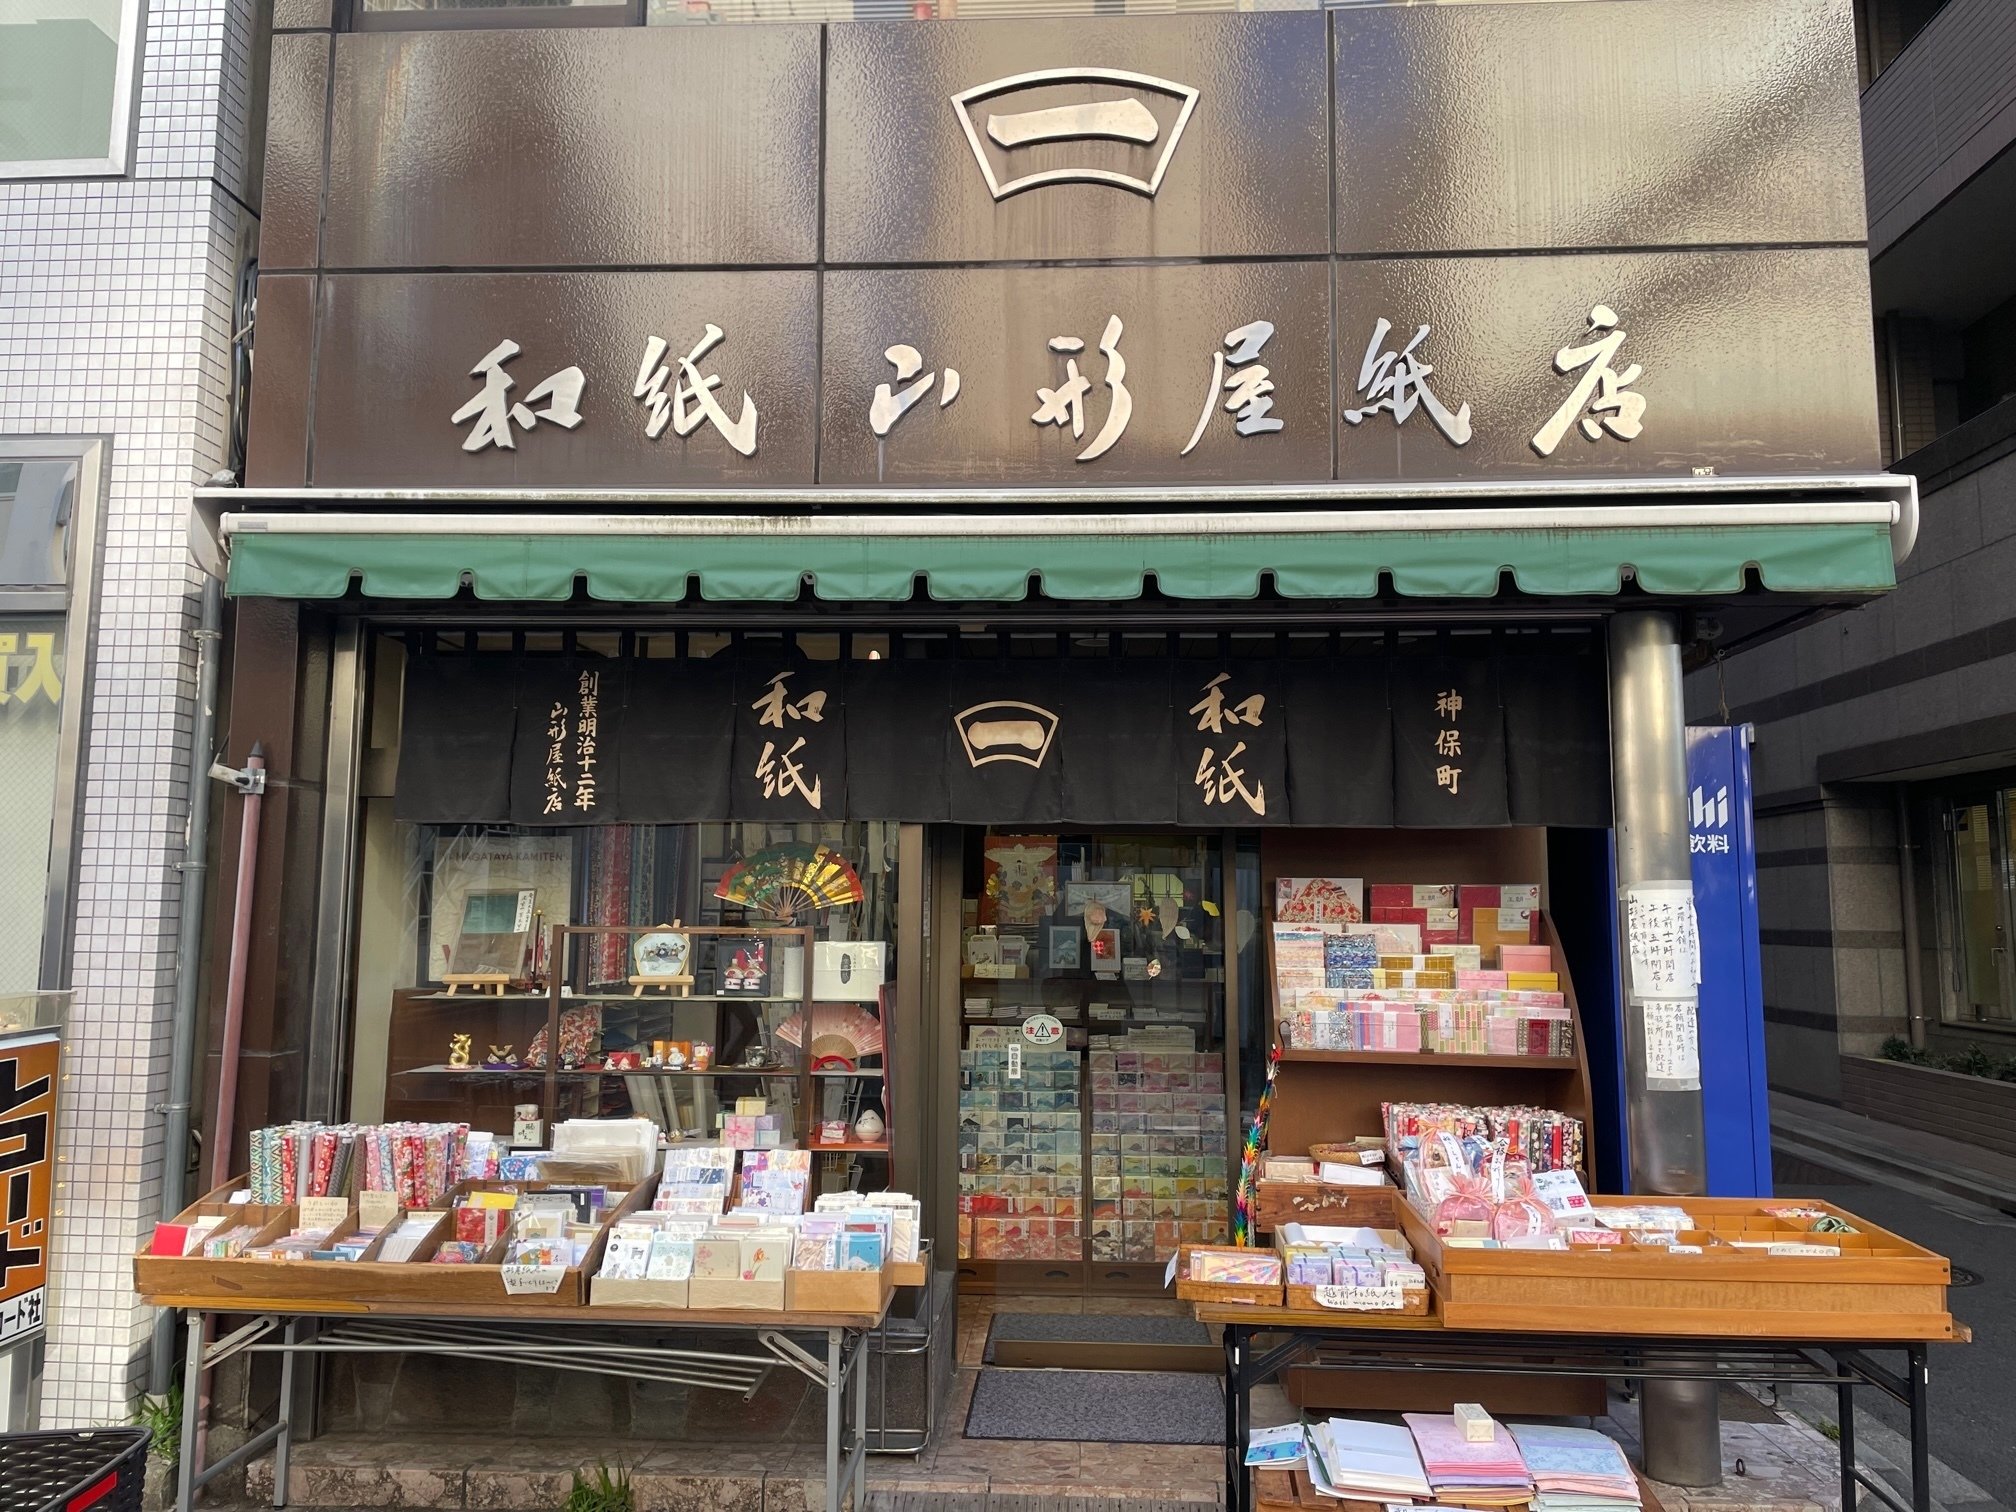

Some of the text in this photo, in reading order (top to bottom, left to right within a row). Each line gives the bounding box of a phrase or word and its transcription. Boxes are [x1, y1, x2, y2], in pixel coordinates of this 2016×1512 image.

[543, 702, 569, 815] 山形屋紙店
[573, 669, 599, 811] 創業明治十二年
[751, 671, 827, 810] 和紙
[1189, 672, 1266, 816] 和紙
[1434, 689, 1463, 795] 神保町
[1688, 786, 1728, 829] hi
[1690, 834, 1729, 853] 飲料
[1629, 894, 1640, 956] 山形屋紙店
